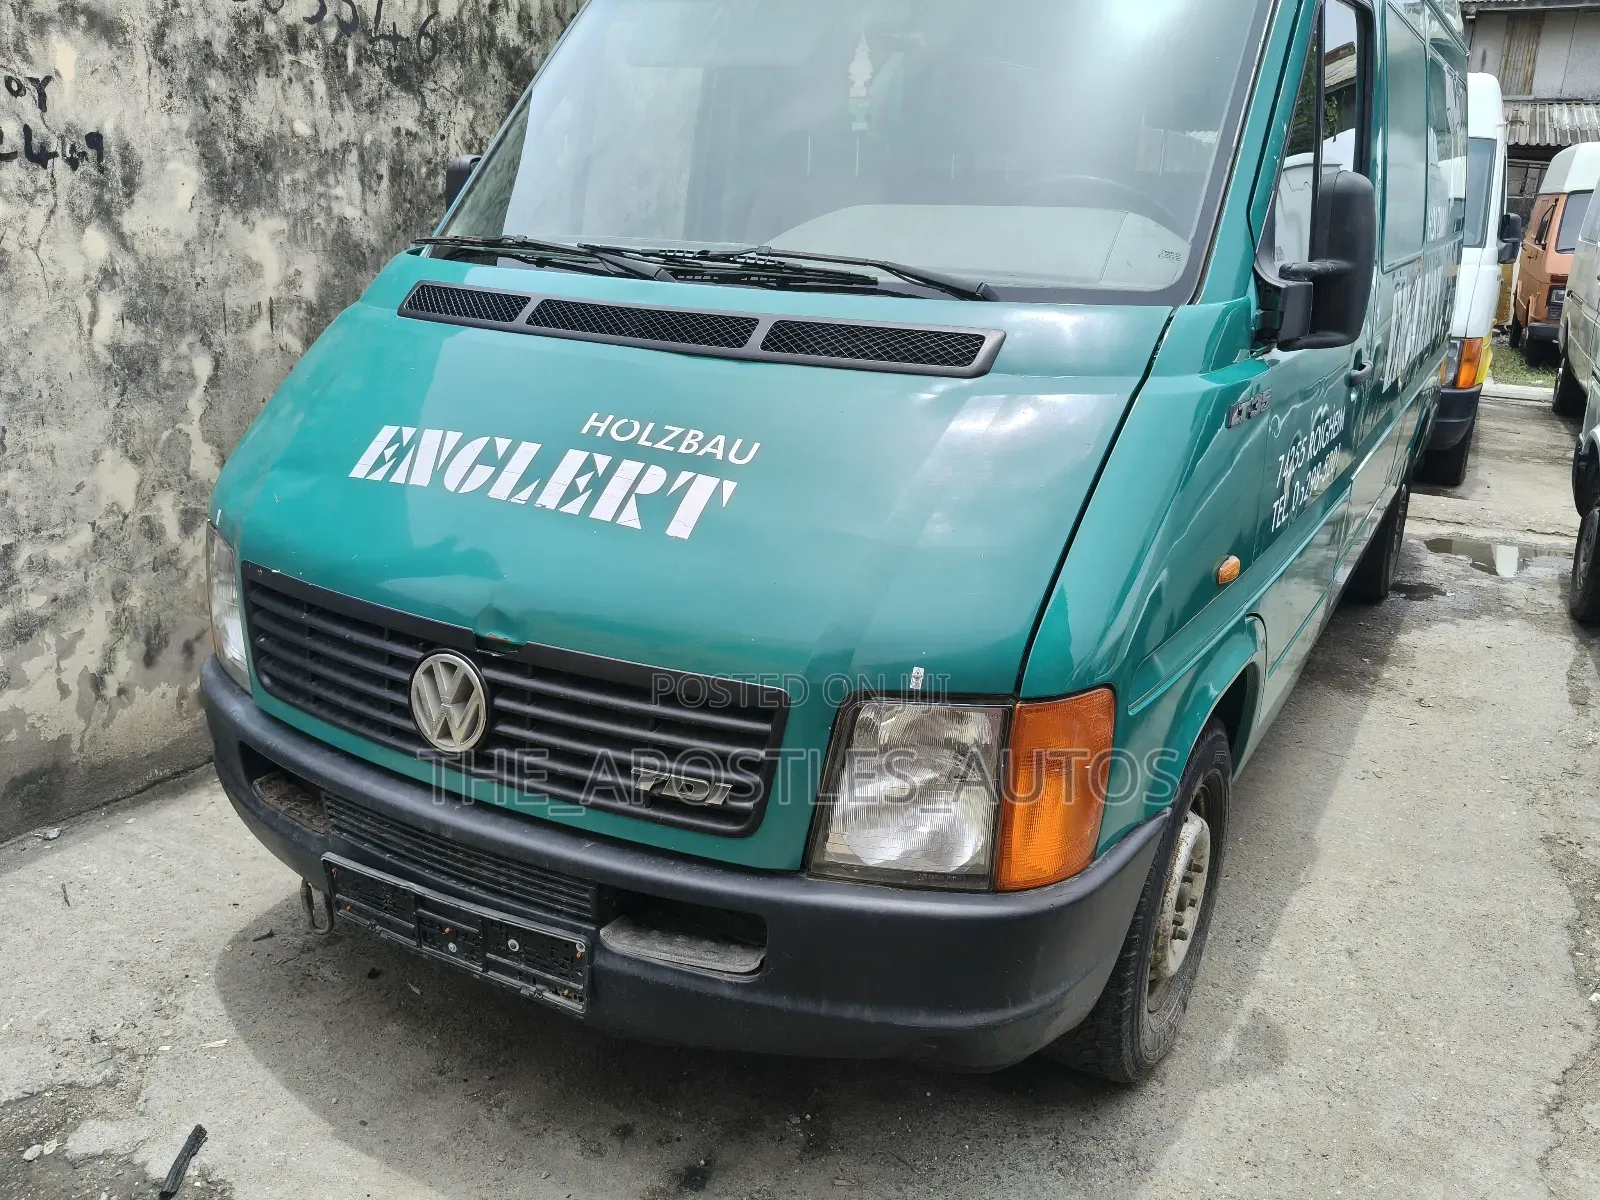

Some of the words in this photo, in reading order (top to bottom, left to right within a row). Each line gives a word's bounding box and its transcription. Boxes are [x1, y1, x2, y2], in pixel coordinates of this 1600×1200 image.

[580, 412, 761, 465] HOLZBAU
[348, 425, 738, 540] ENGLERT
[631, 766, 734, 806] TDI
